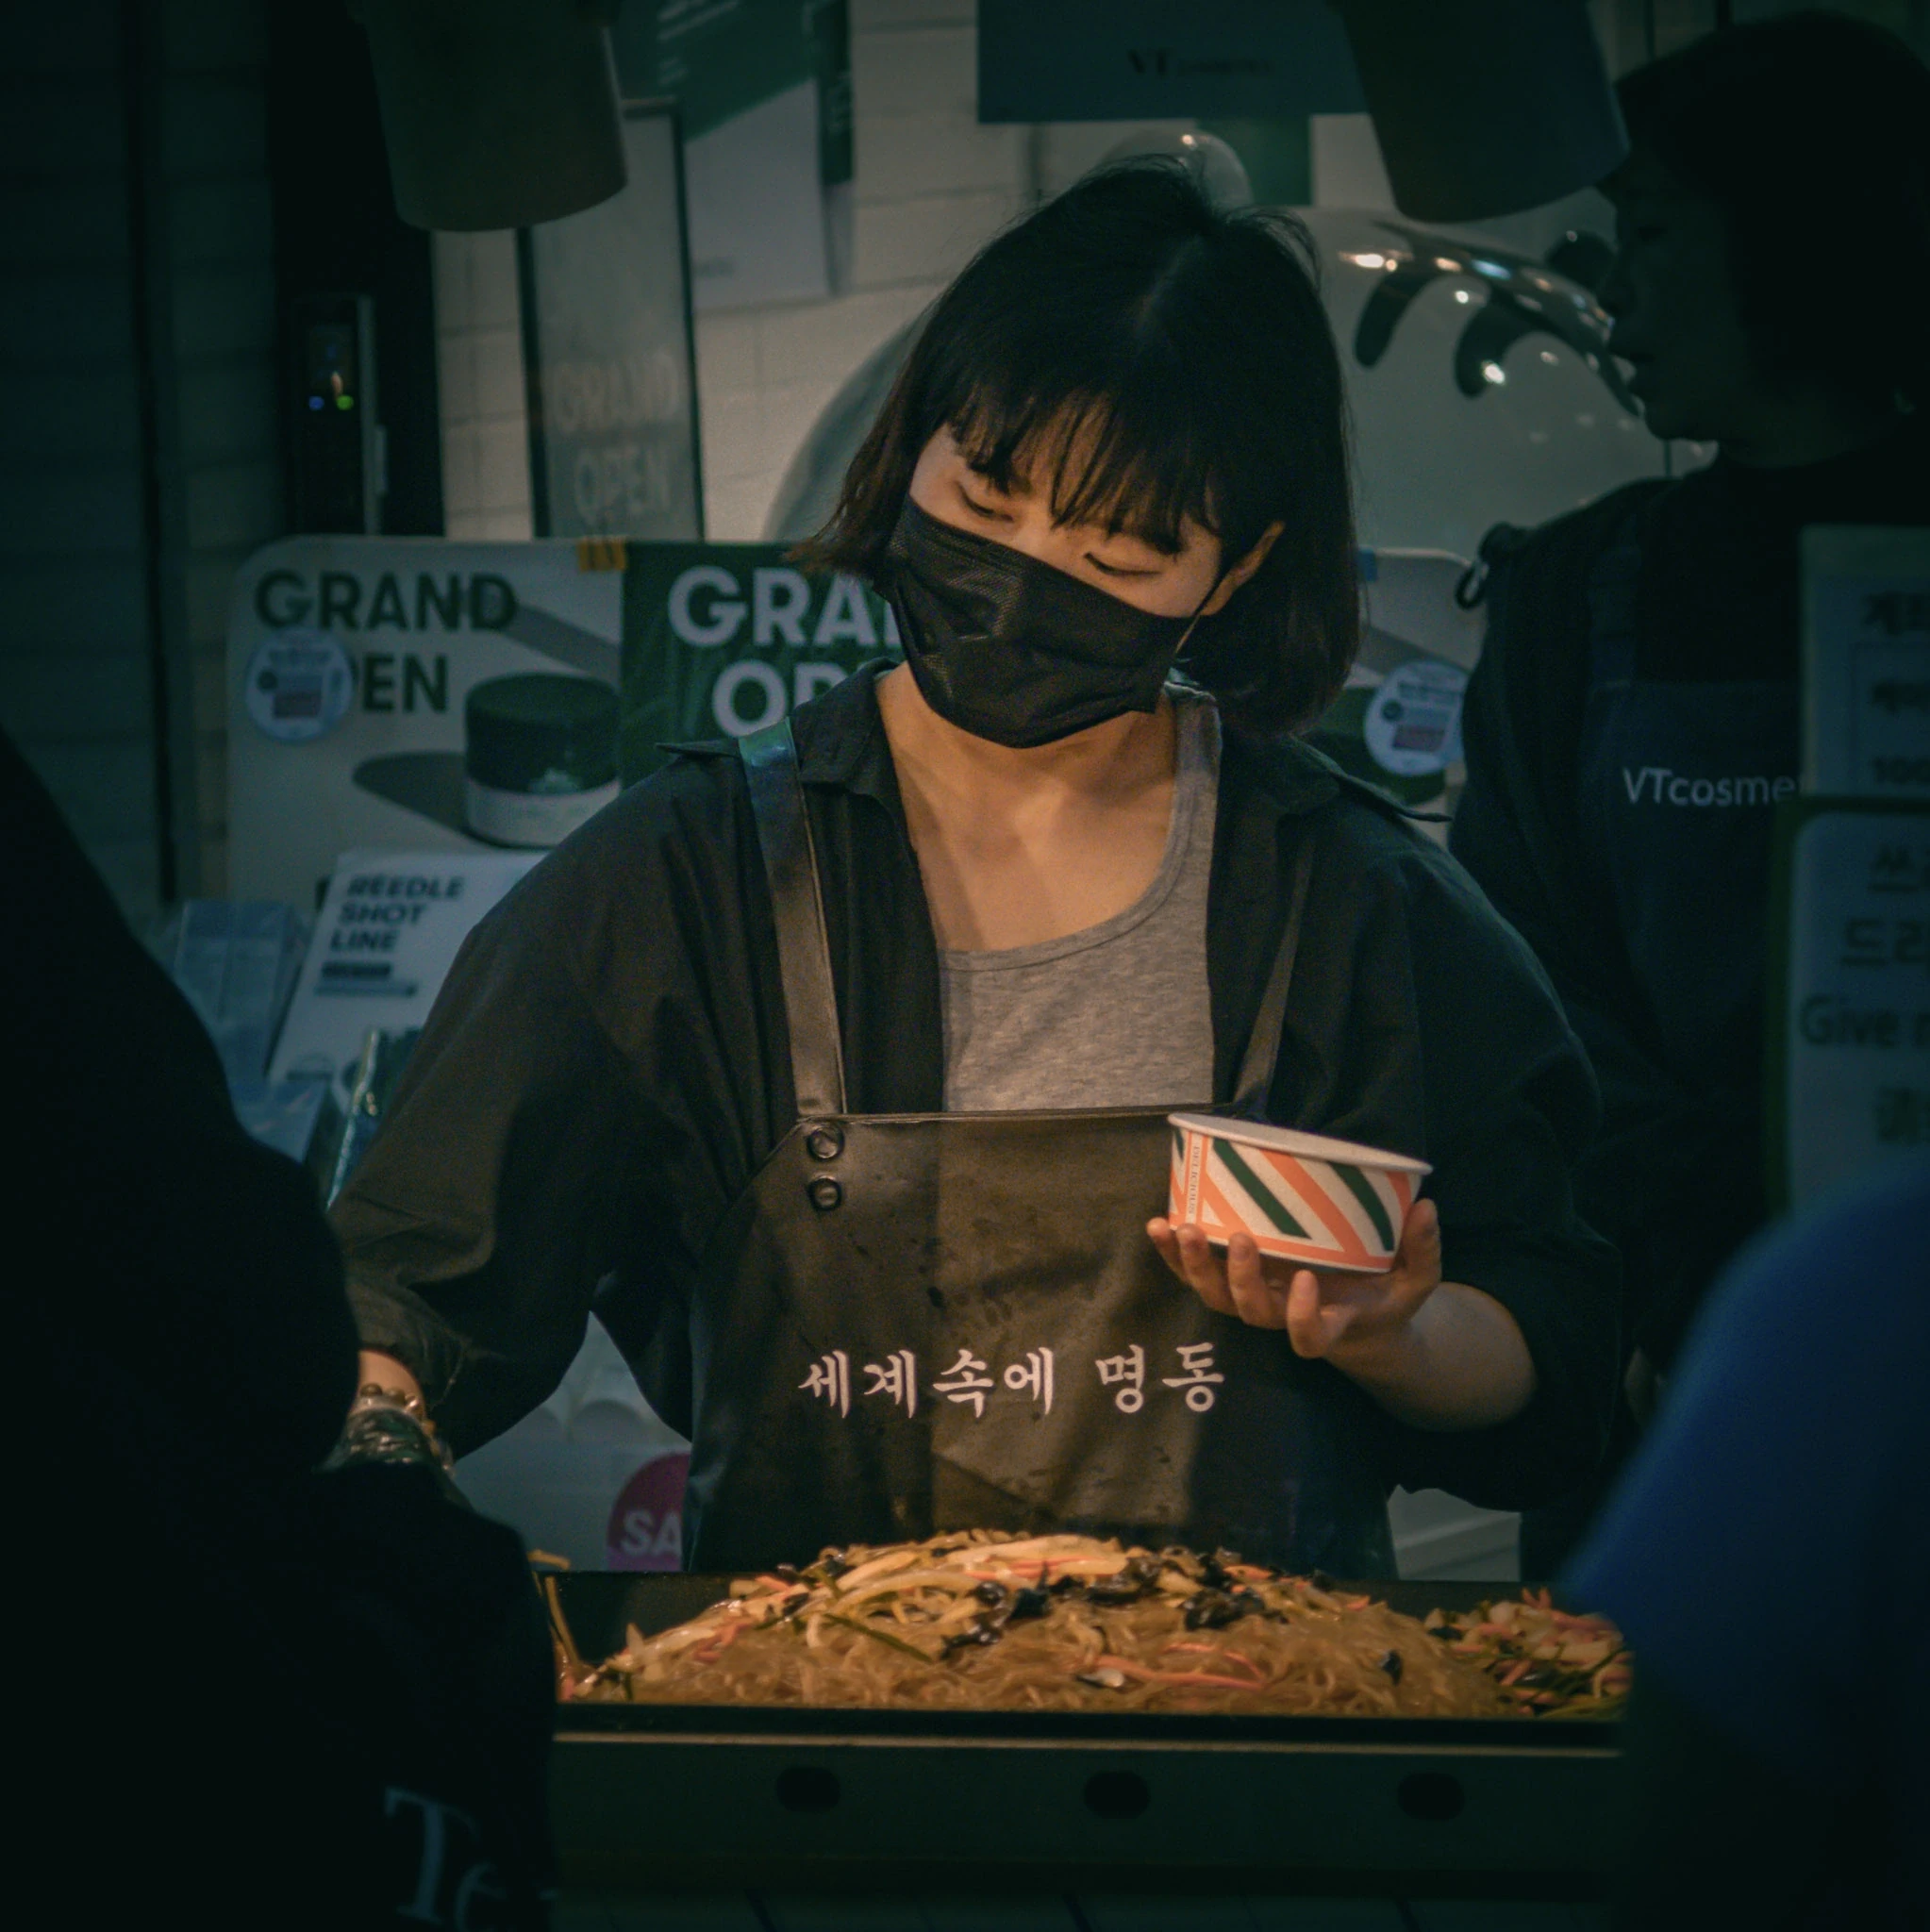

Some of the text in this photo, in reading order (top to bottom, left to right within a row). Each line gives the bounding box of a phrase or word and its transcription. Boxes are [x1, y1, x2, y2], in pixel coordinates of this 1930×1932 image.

[254, 568, 517, 631] GRAND
[349, 653, 448, 713] EN
[1622, 765, 1804, 808] VTcosme
[330, 928, 398, 952] LINE
[339, 902, 424, 925] SHOT
[1800, 995, 1898, 1049] Give
[1094, 1341, 1225, 1414] 명동
[383, 1785, 559, 1932] Te
